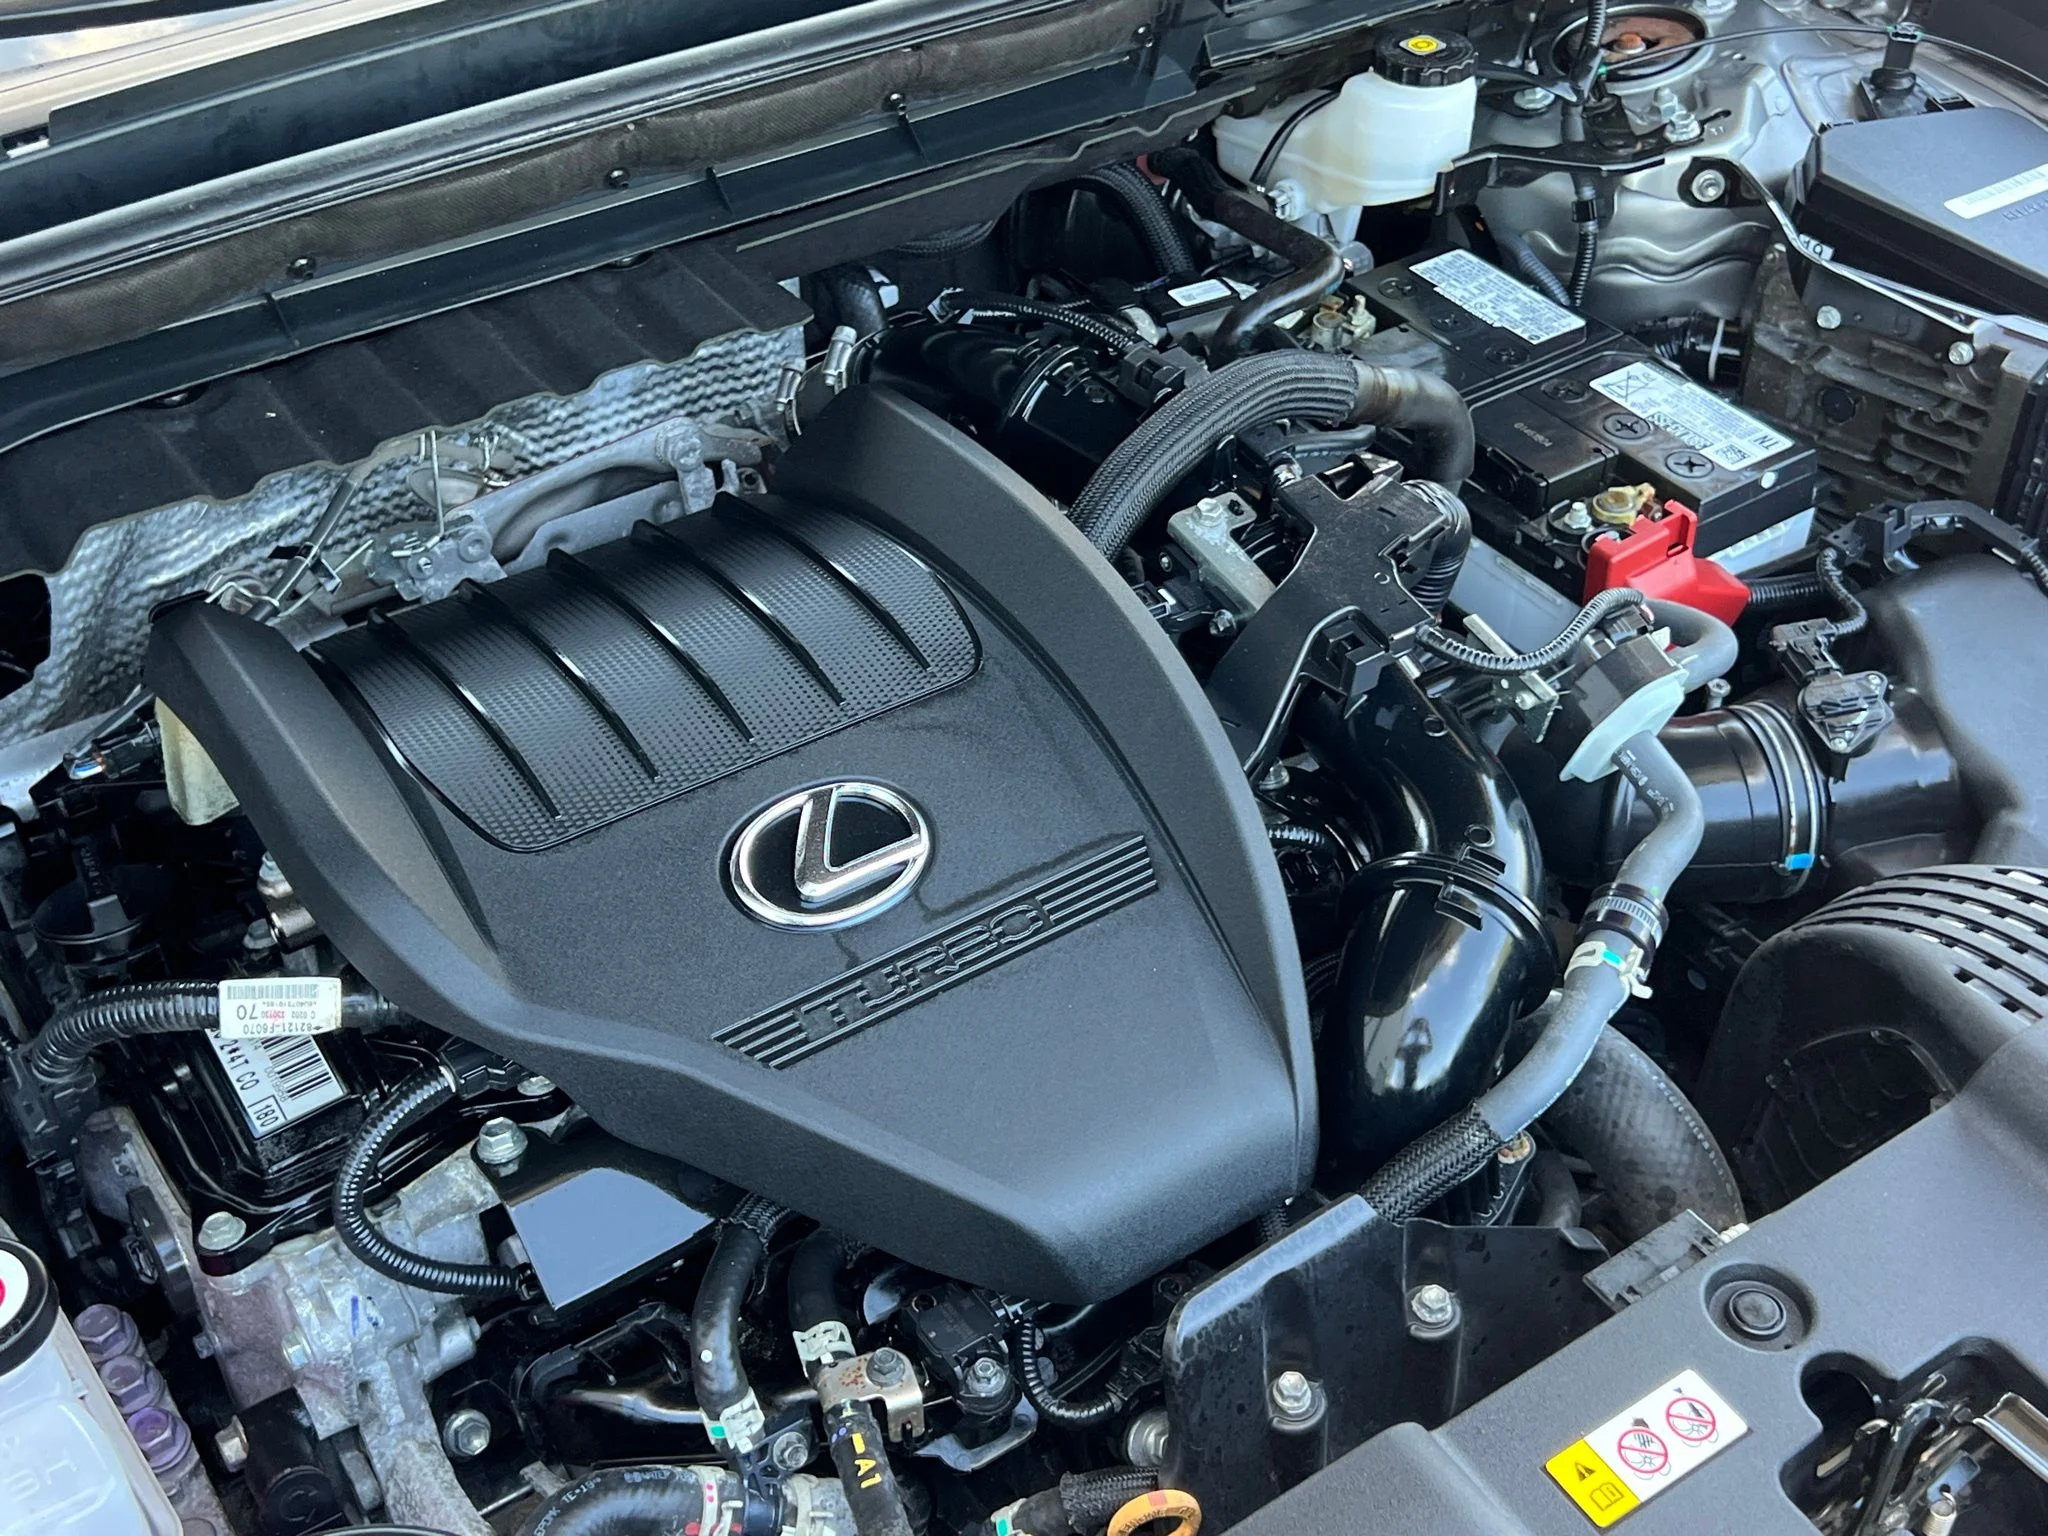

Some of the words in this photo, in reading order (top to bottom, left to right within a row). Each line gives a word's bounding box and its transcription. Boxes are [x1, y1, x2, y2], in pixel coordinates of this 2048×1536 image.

[797, 902, 1044, 1041] TURBO
[236, 1004, 258, 1021] 70
[235, 1071, 260, 1091] CO
[253, 1104, 279, 1128] 180
